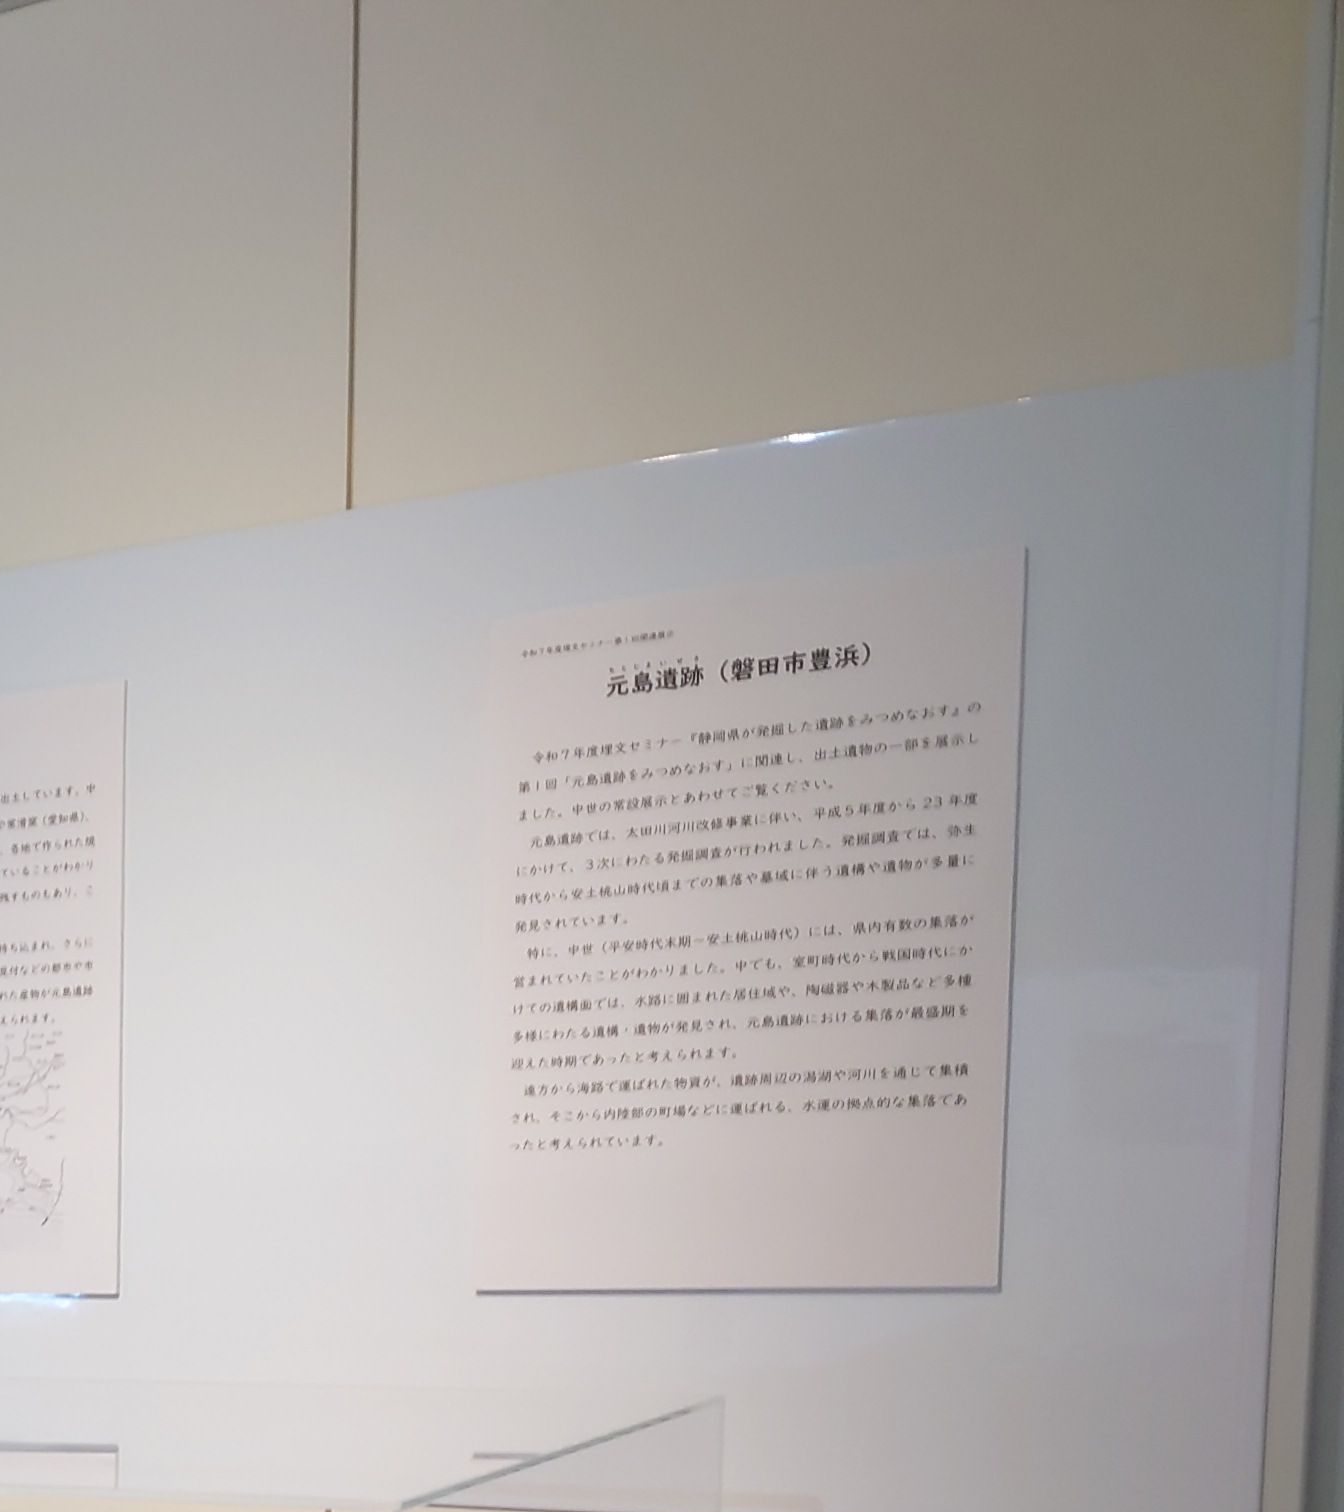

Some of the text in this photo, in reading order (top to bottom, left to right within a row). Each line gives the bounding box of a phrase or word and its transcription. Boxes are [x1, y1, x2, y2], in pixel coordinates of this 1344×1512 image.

[606, 641, 874, 698] 元島遺跡（磐田市豊浜）
[514, 912, 630, 935] 発見されています。
